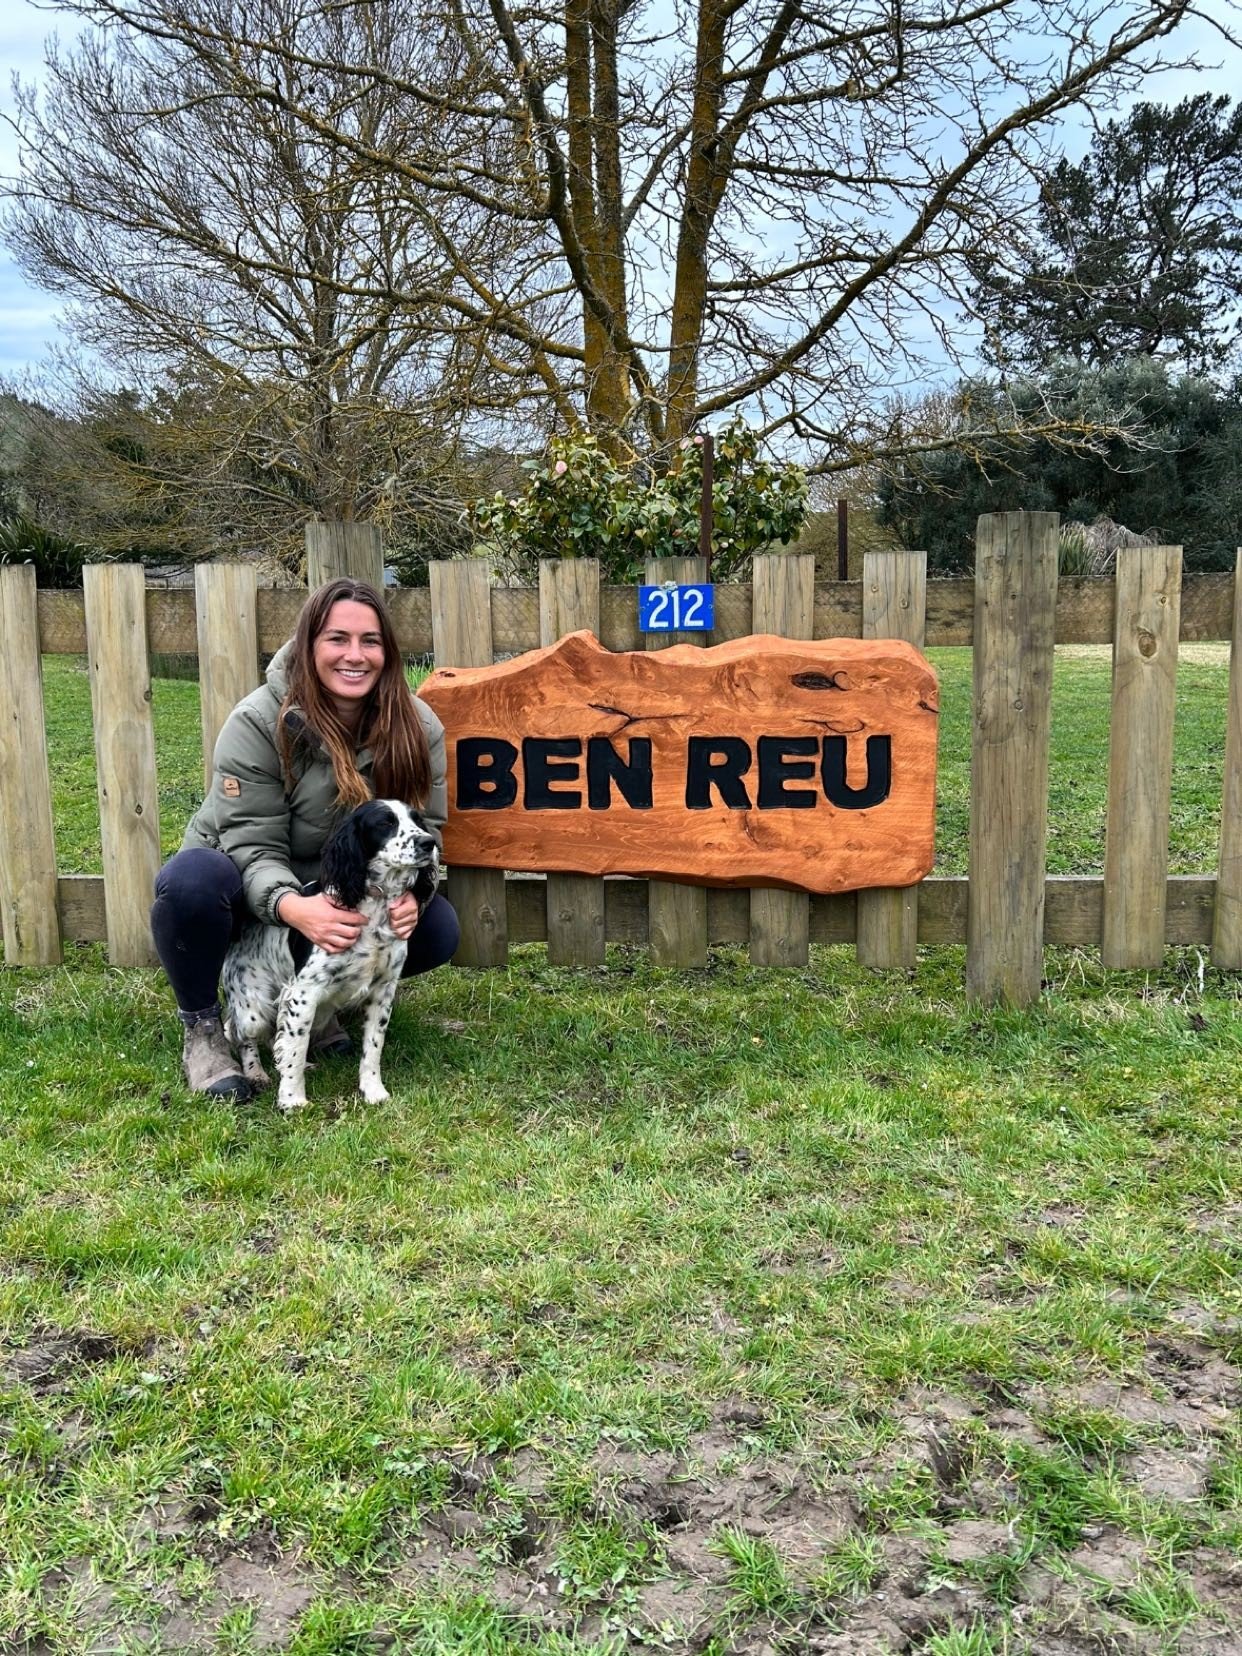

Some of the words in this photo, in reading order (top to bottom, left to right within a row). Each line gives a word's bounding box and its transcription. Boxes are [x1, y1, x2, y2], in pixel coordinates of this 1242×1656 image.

[648, 589, 704, 628] 212
[456, 737, 653, 810] BEN
[686, 734, 891, 810] REU
